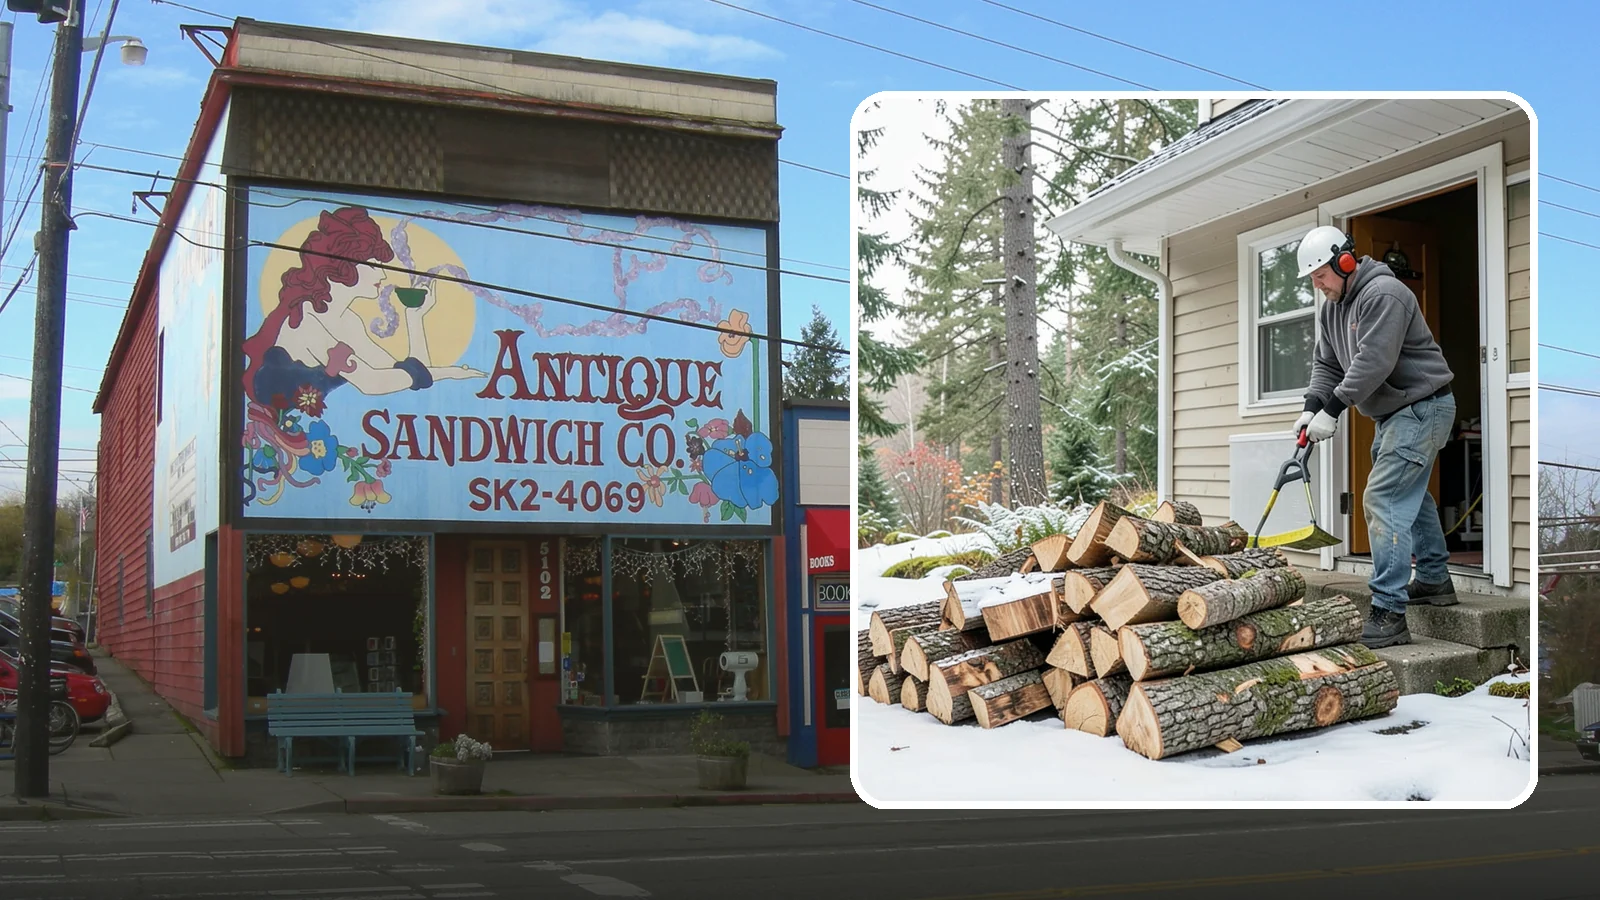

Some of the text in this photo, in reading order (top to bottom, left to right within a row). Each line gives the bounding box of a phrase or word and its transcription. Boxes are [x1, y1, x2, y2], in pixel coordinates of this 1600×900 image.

[476, 329, 723, 420] ANTIQUE
[361, 408, 684, 468] SANDWICH CO.
[469, 477, 646, 513] SK2-4069
[540, 542, 551, 599] 5102
[809, 555, 834, 569] BOOKS
